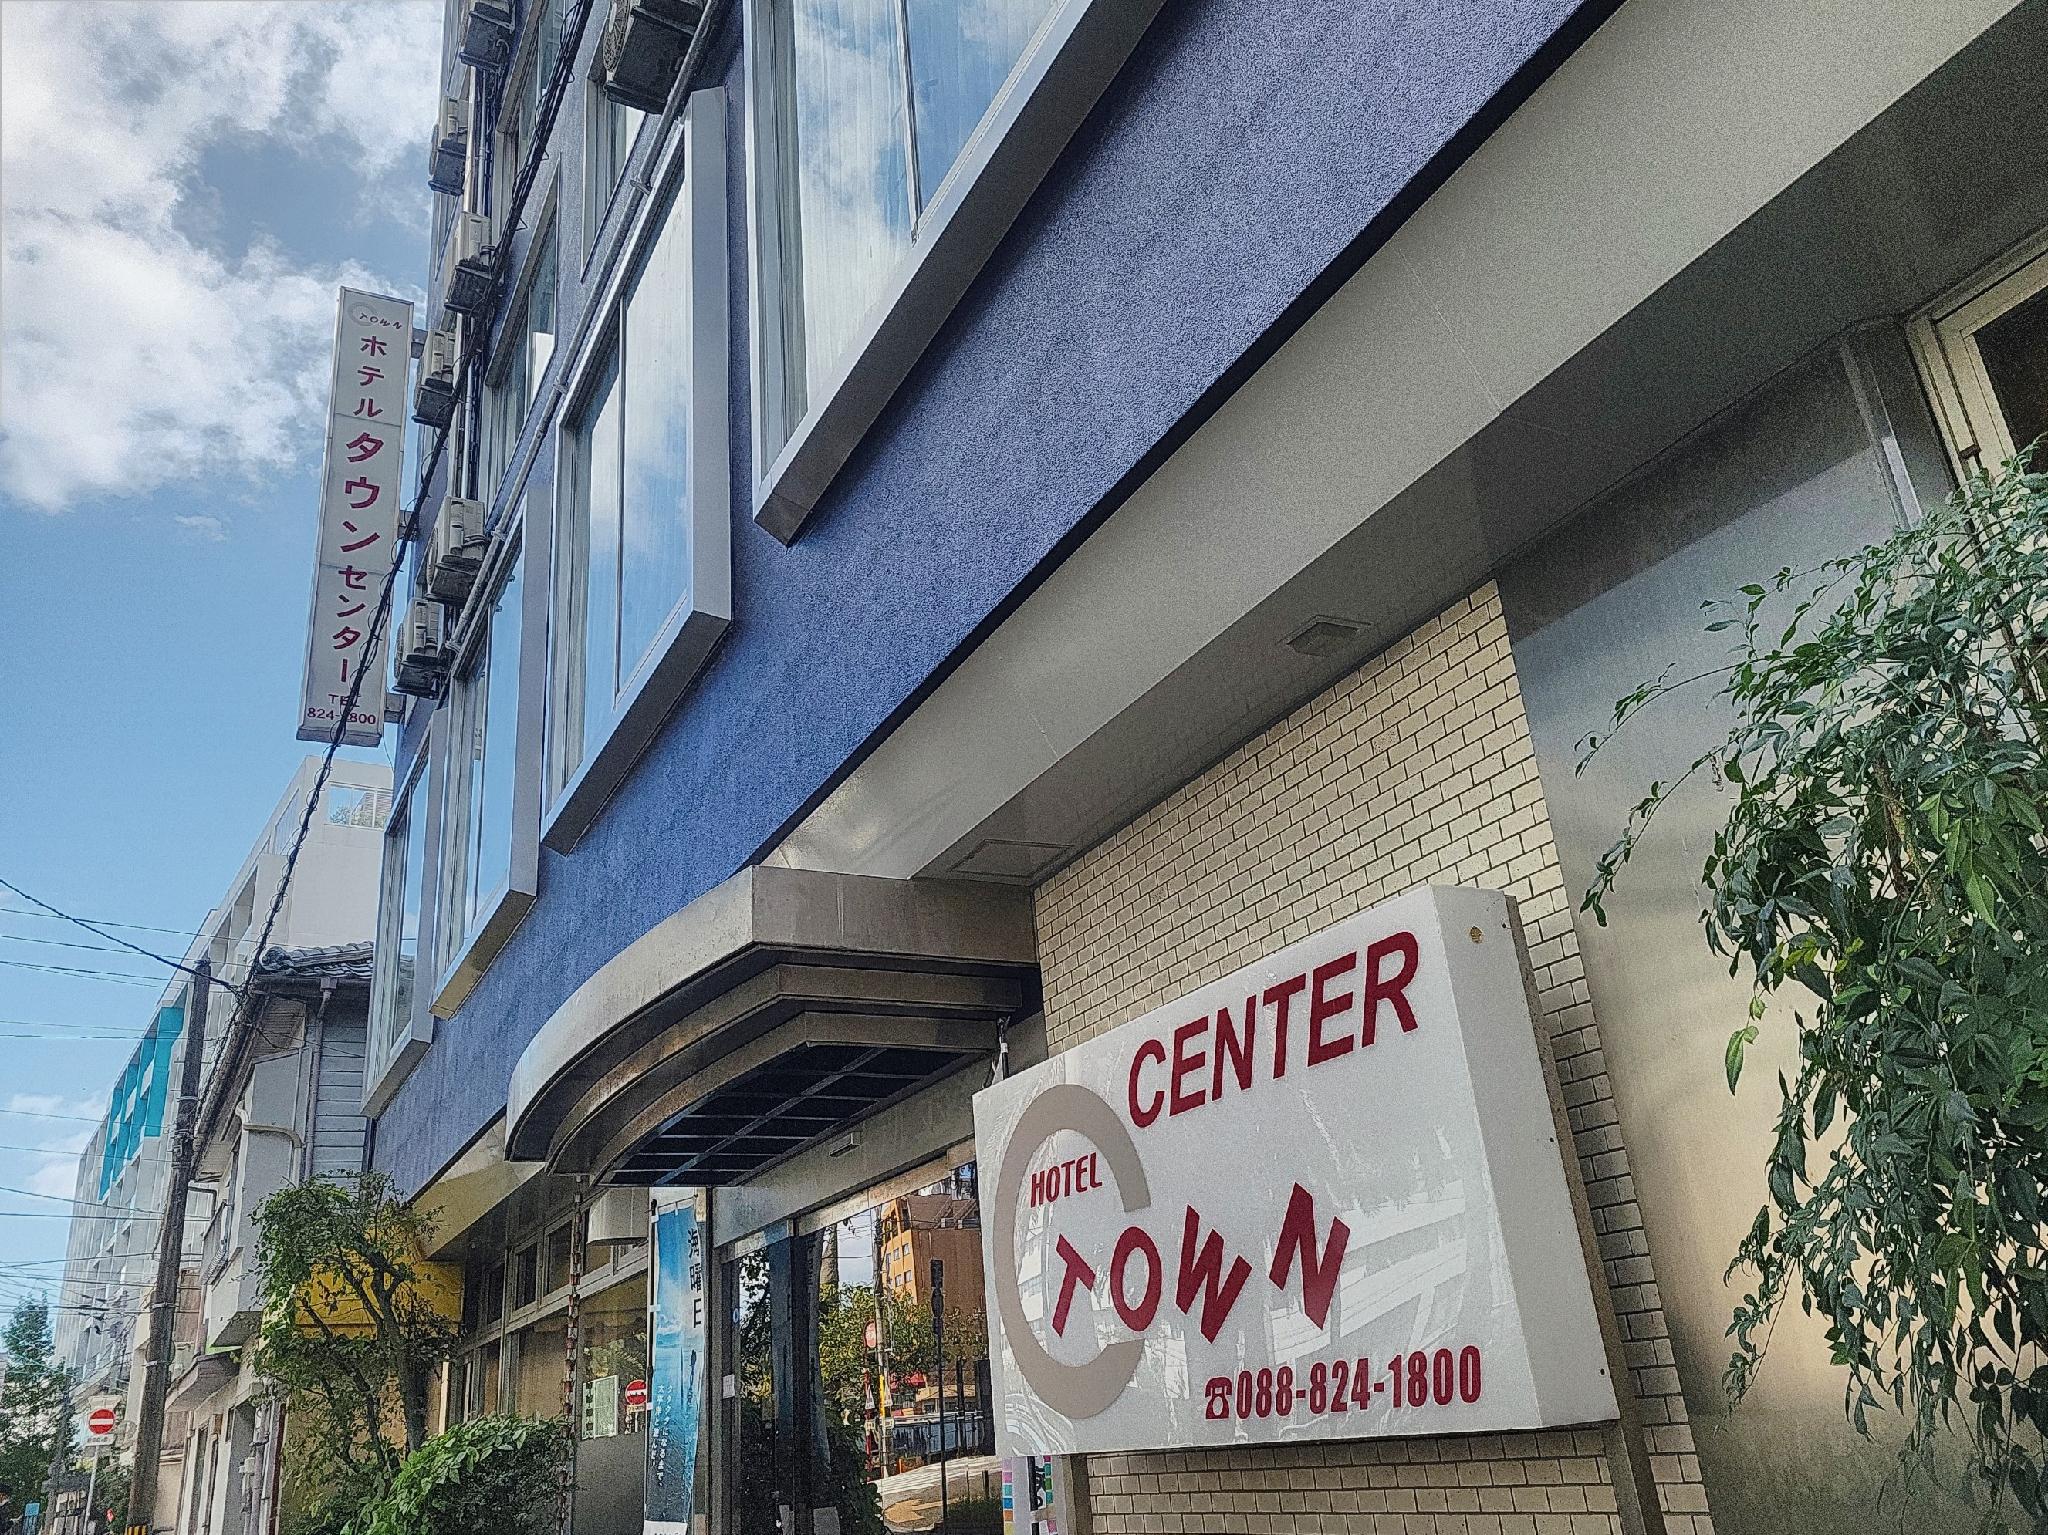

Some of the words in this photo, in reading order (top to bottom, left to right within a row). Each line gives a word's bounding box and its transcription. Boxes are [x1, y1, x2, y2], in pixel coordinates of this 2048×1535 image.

[359, 312, 402, 330] TOWN
[332, 335, 387, 683] ホテルタウンセンター
[307, 707, 376, 725] 824-800
[1127, 931, 1419, 1129] CENTER
[1030, 1152, 1103, 1208] HOTEL
[1051, 1182, 1351, 1343] TOWN
[1236, 1344, 1482, 1420] 088-824-1800
